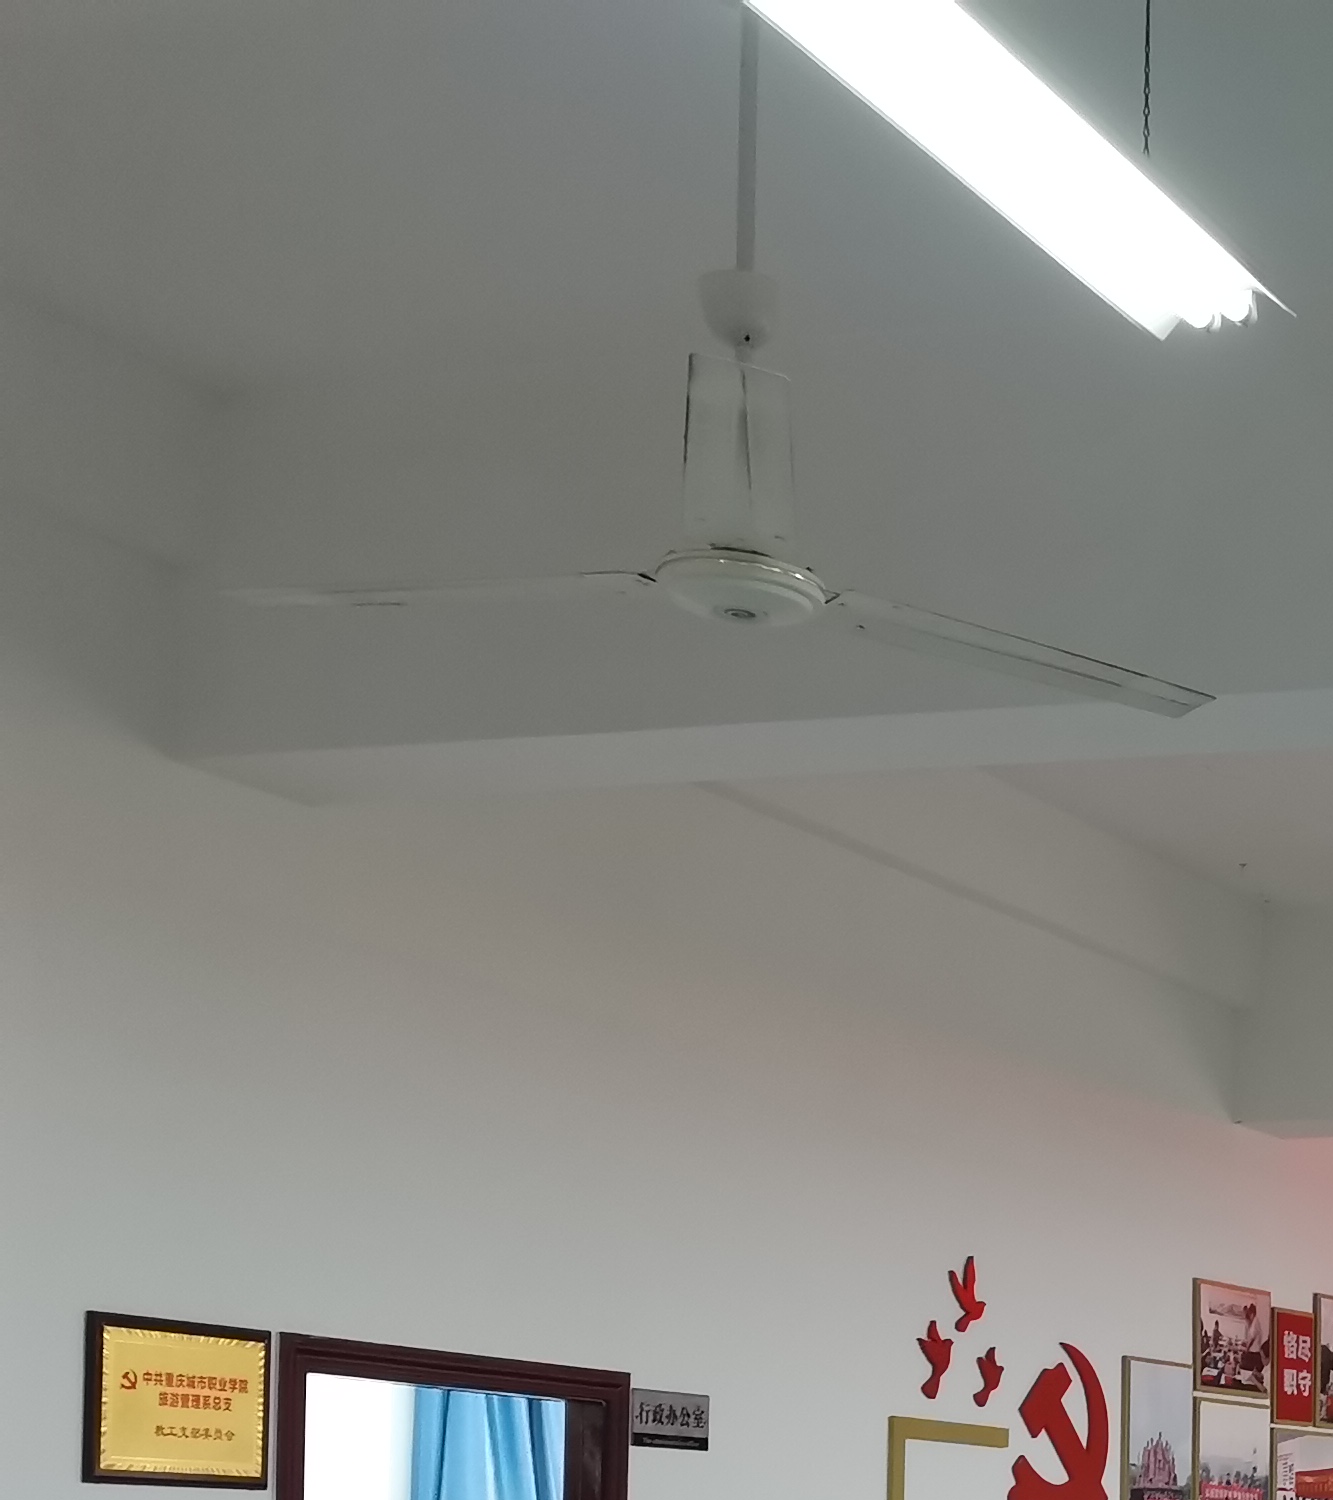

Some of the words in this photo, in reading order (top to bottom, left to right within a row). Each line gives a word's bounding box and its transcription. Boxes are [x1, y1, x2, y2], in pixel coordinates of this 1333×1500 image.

[1283, 1330, 1311, 1362] 恪尽
[142, 1370, 249, 1393] 中共重庆城市职业学院
[1283, 1368, 1312, 1397] 职守
[158, 1391, 233, 1411] 旅游管理系总支
[635, 1402, 706, 1429] 行政办公室
